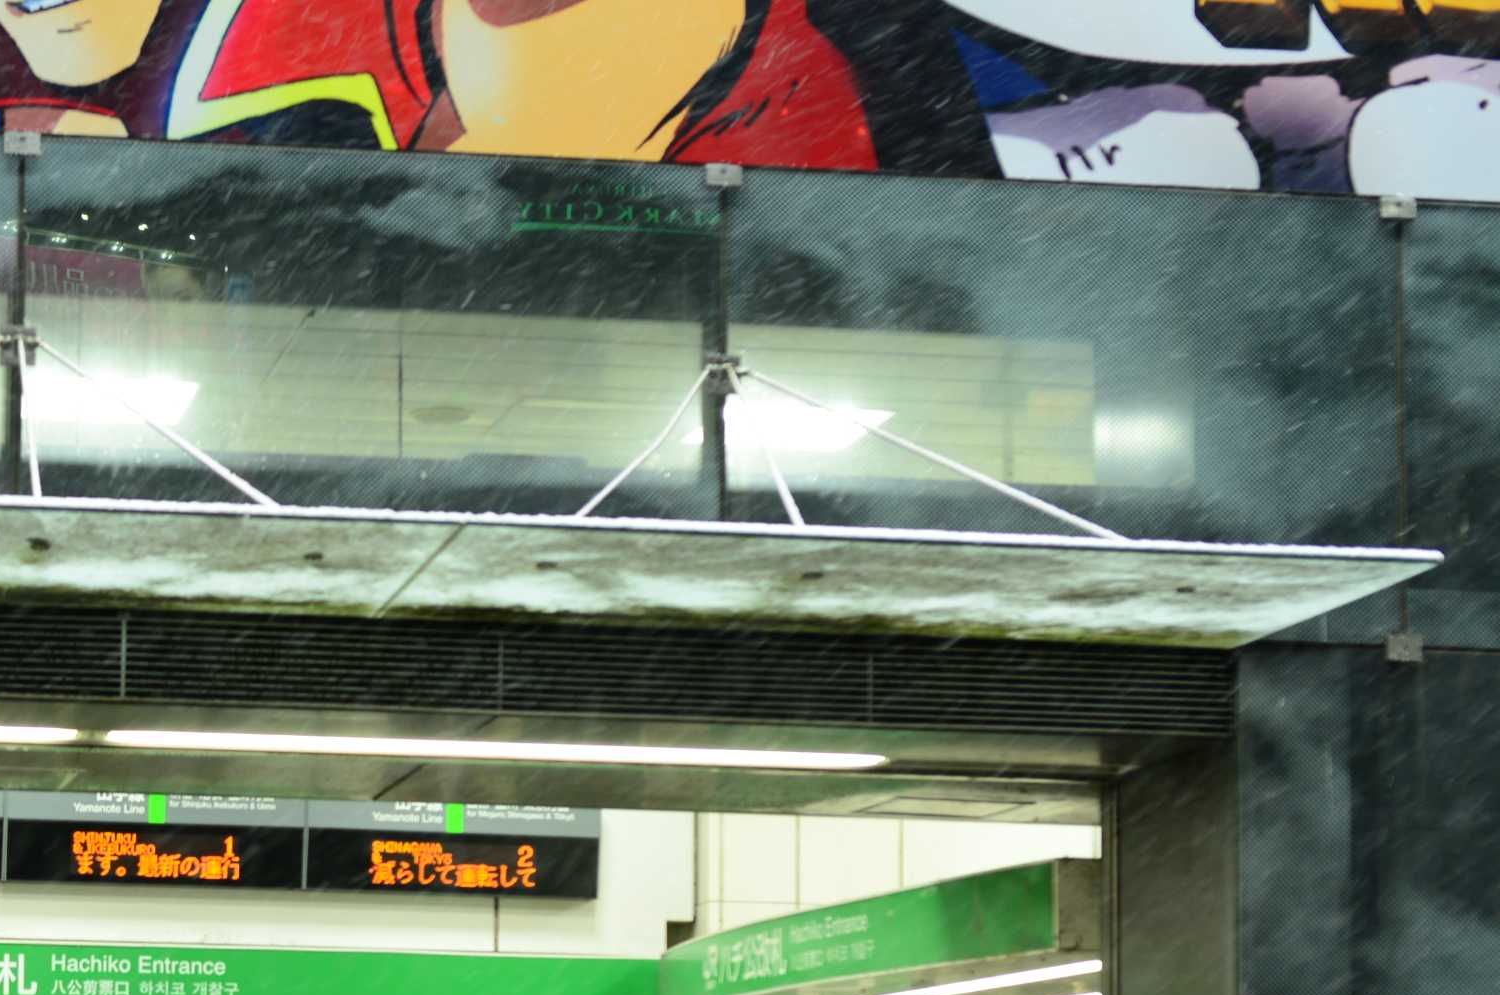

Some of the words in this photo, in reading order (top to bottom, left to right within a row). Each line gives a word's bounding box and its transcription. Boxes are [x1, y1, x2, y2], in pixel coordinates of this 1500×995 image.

[73, 802, 121, 814] Yamanote
[124, 803, 146, 814] Line
[422, 813, 443, 824] Line
[223, 835, 235, 857] 1
[517, 845, 534, 868] 2
[50, 953, 132, 973] Hachiko
[137, 955, 227, 976] Entrance
